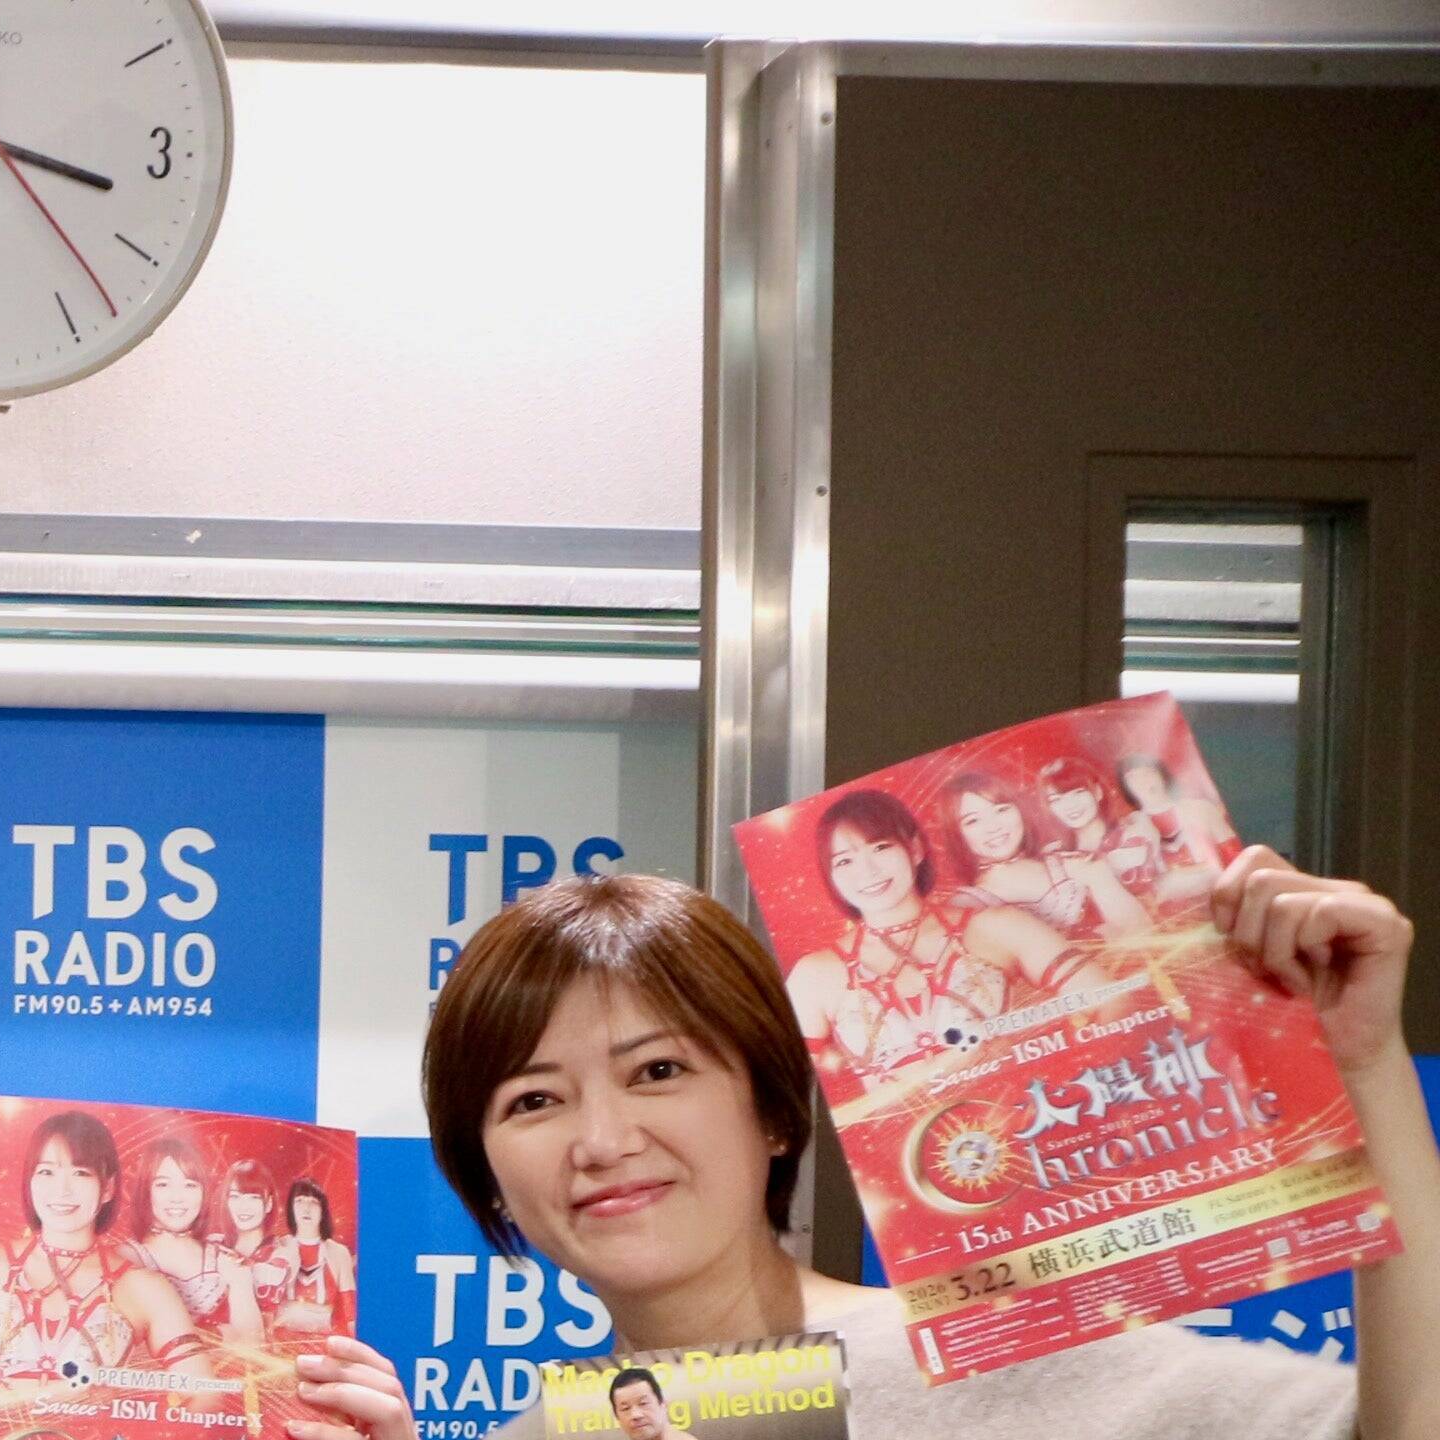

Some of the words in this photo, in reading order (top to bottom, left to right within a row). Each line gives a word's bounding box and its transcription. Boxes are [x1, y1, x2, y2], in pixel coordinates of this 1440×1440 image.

[146, 126, 173, 180] 3
[12, 825, 219, 921] TBS
[13, 930, 216, 988] RADIO
[1074, 1004, 1170, 1044] Chapter
[958, 1224, 1013, 1254] 15th
[1021, 1137, 1278, 1236] ANNIVERSARY
[951, 1263, 1016, 1301] 3.22
[1027, 1206, 1198, 1282] 横浜武道館
[416, 1254, 613, 1348] TBS
[96, 1368, 190, 1390] PREMATEX
[414, 1357, 542, 1412] RAD
[684, 1345, 833, 1384] Dragon
[165, 1406, 248, 1428] Chapter
[697, 1381, 837, 1421] Method
